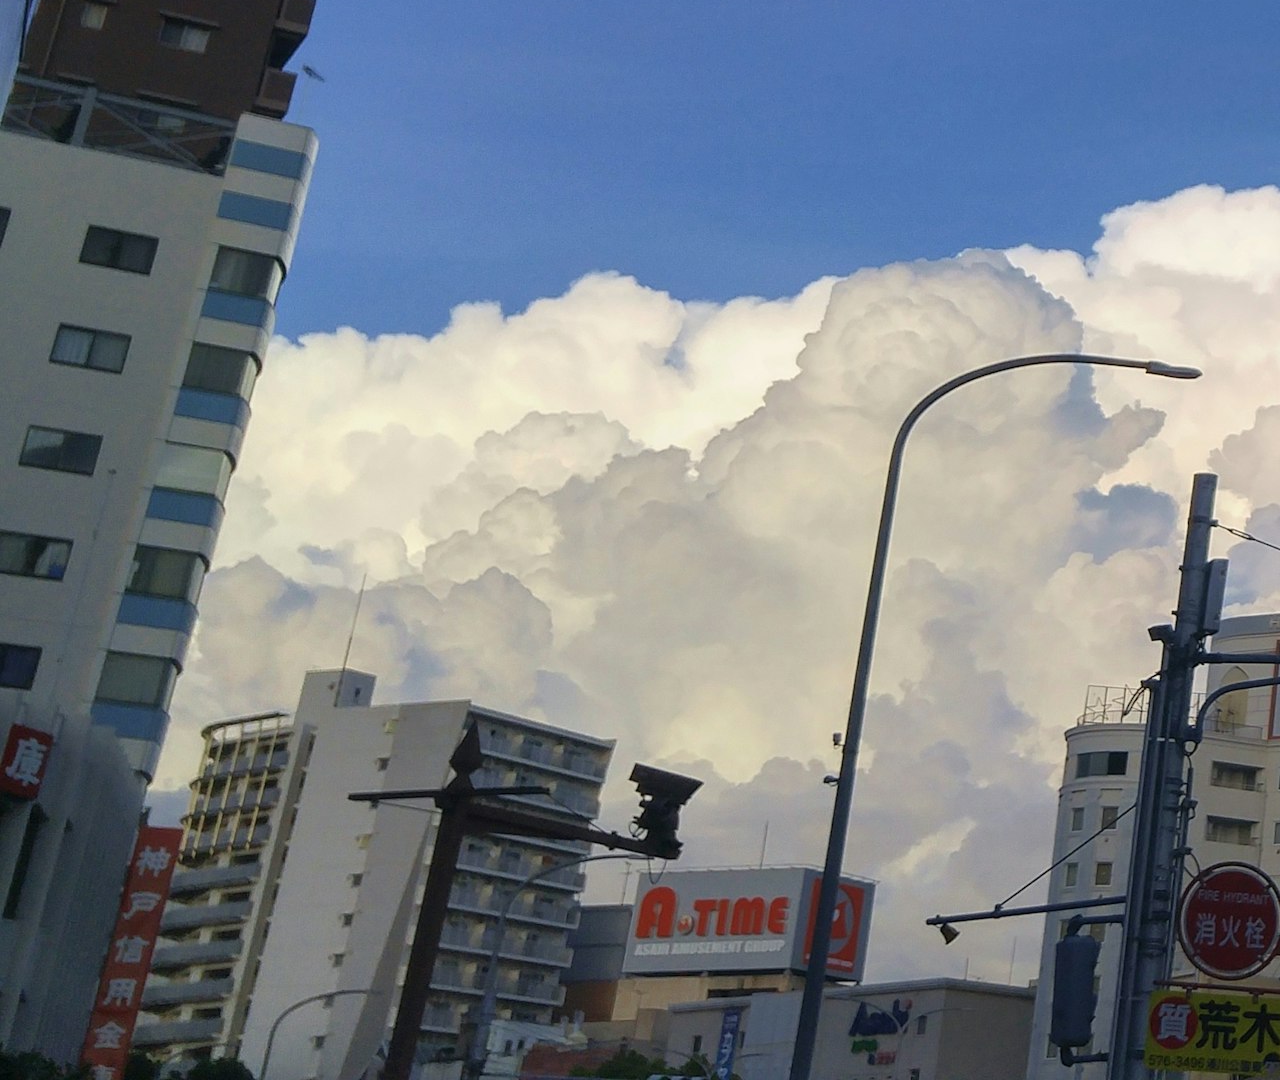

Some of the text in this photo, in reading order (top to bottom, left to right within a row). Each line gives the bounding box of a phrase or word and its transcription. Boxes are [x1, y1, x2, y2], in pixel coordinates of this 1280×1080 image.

[1198, 888, 1270, 905] FIRE HYDRANT
[1194, 912, 1267, 949] 消火栓
